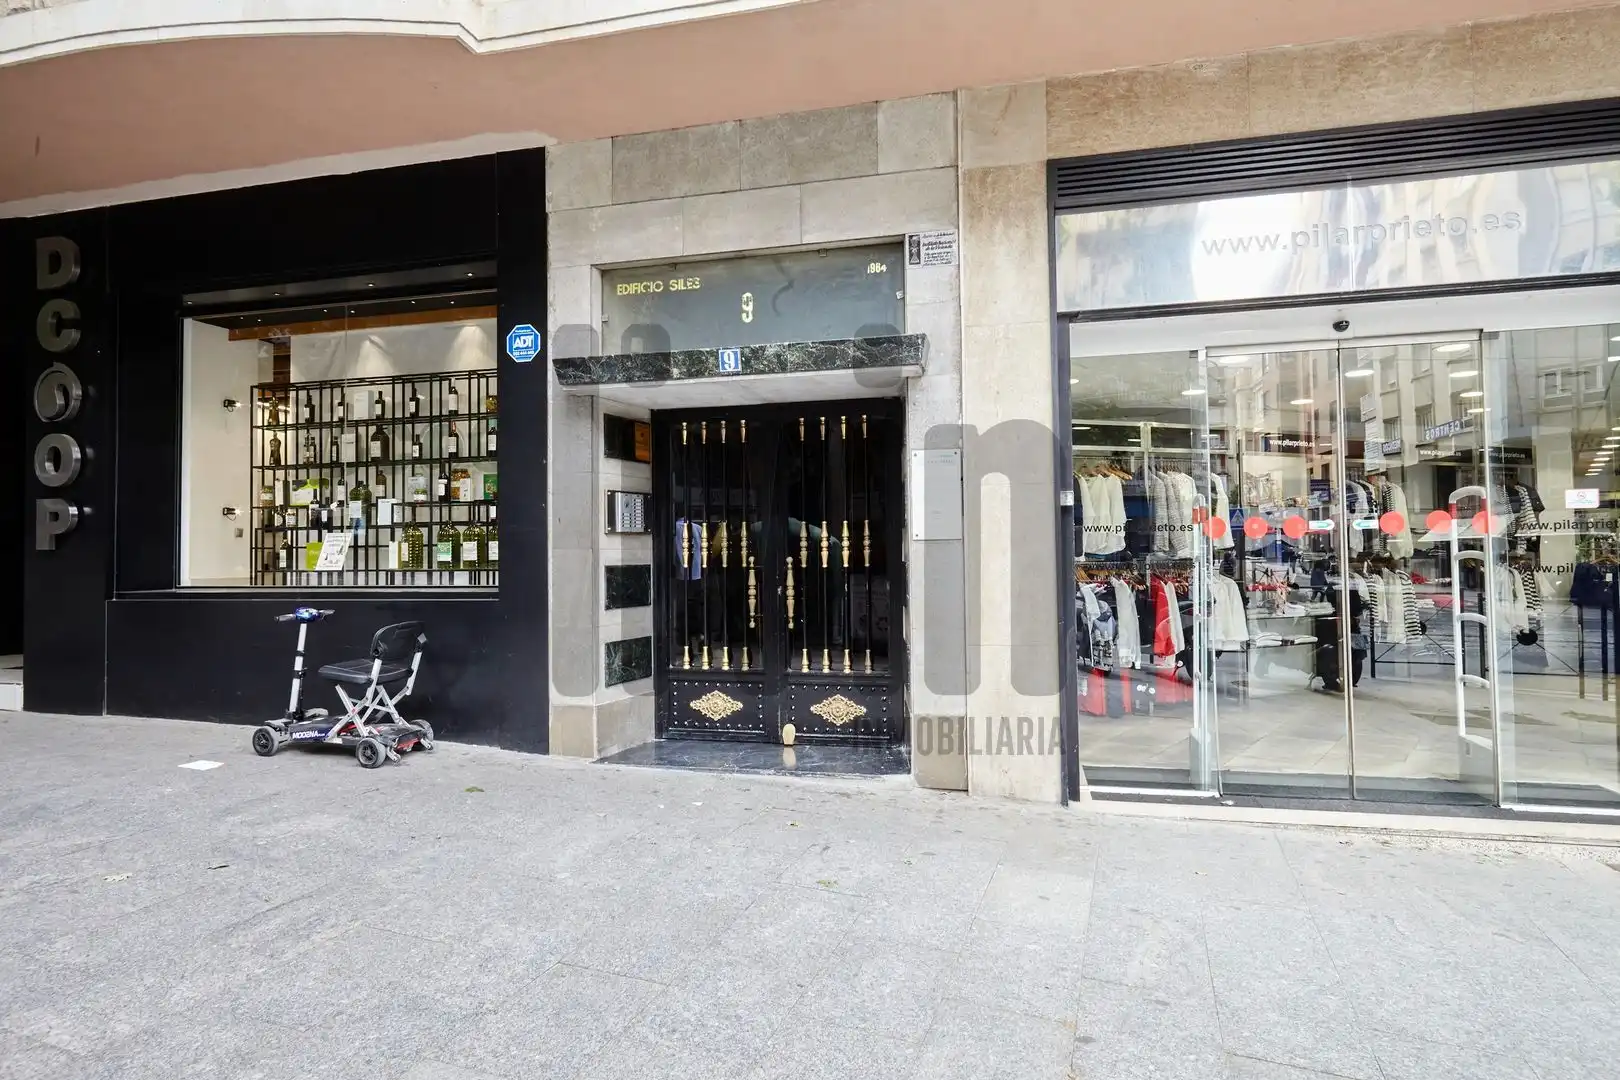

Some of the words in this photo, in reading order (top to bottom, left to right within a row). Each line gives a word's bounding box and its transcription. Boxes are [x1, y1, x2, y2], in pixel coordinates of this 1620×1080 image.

[1202, 211, 1521, 255] www.pilarprieto.es
[616, 281, 664, 296] EDIFICIO
[669, 277, 701, 291] SILES
[741, 291, 754, 323] 9
[514, 335, 533, 348] ADT
[723, 351, 736, 370] 9
[292, 730, 318, 739] MODENA
